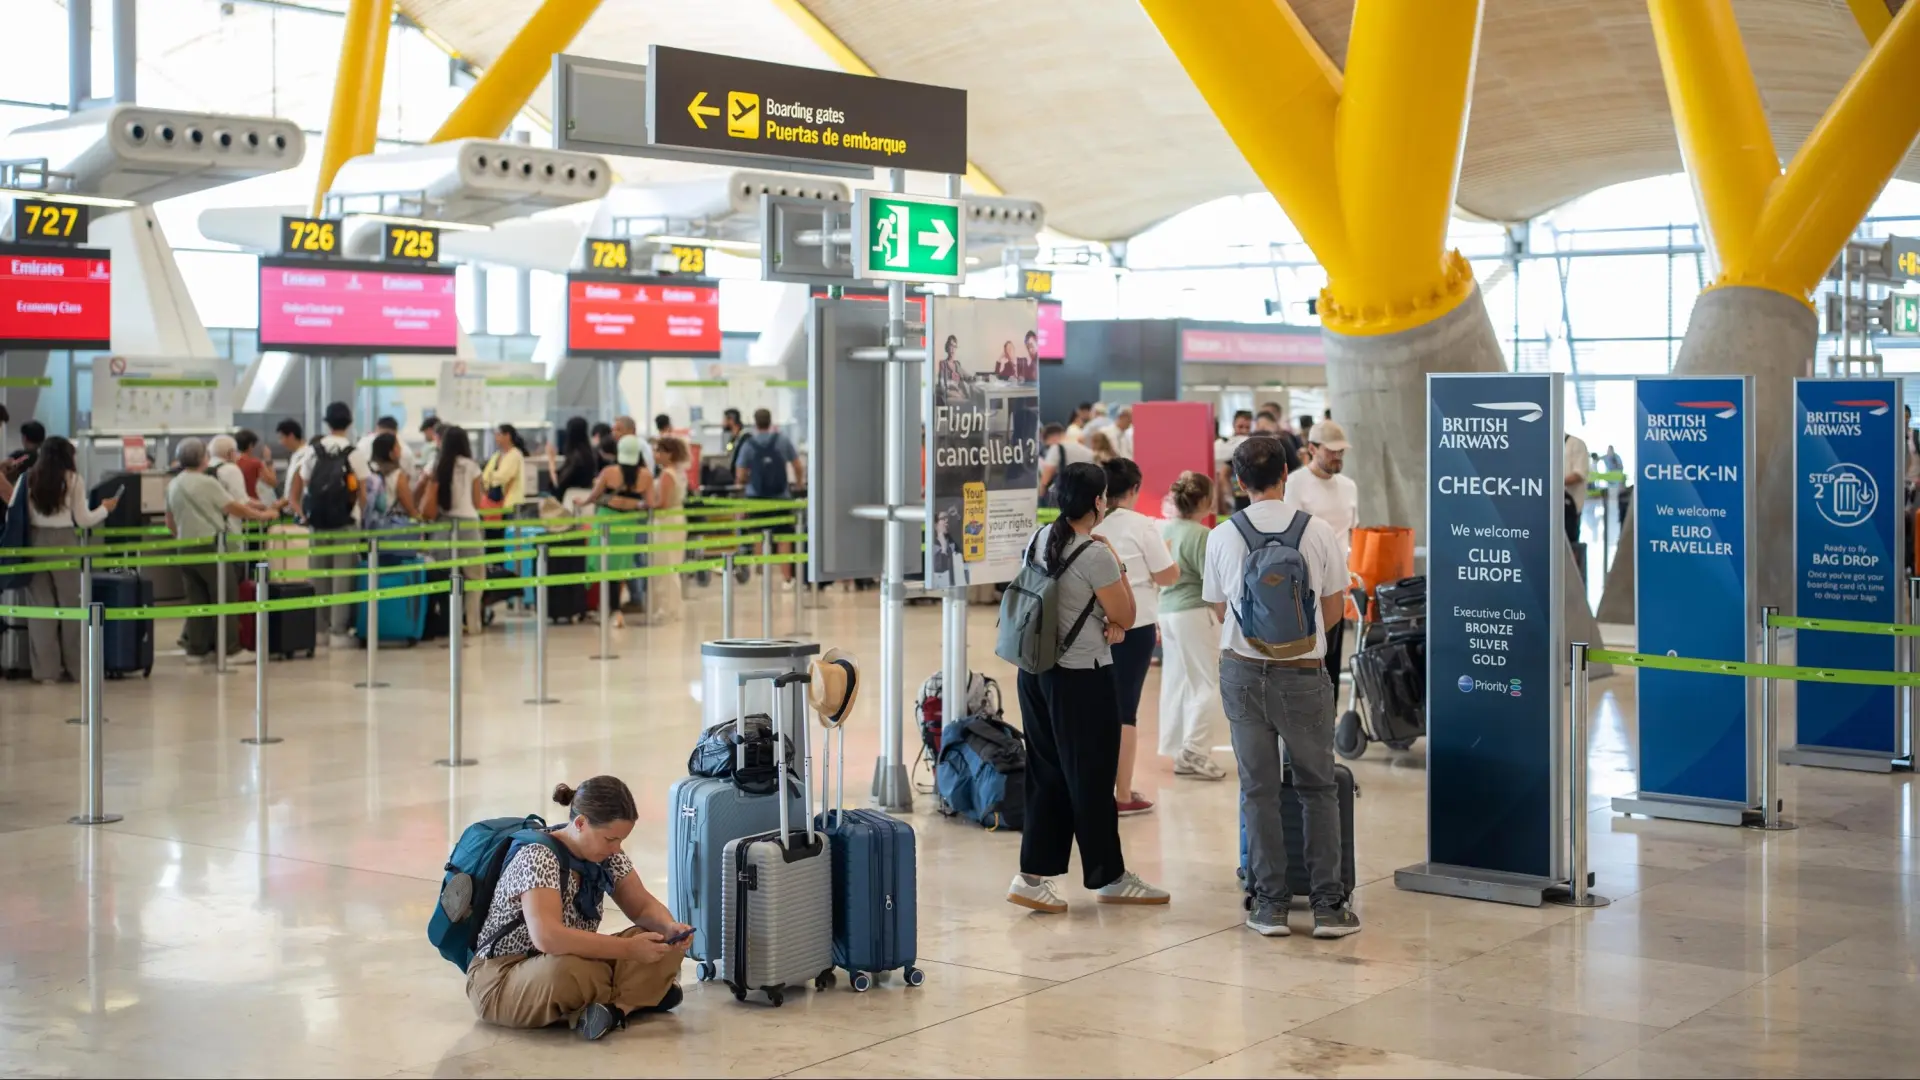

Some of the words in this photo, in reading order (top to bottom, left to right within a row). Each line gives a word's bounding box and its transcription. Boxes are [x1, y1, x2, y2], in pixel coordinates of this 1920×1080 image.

[766, 98, 813, 124] Boarding
[816, 107, 845, 124] gates
[766, 120, 819, 144] Puertas
[822, 127, 839, 146] de
[843, 131, 906, 156] embarque
[24, 205, 79, 236] 727
[290, 221, 335, 251] 726
[391, 229, 435, 259] 725
[592, 242, 627, 268] 724
[11, 259, 64, 276] Emirates
[936, 405, 990, 439] Flight
[1648, 414, 1706, 428] BRITISH
[1806, 411, 1860, 424] BRITISH
[1442, 417, 1507, 433] BRITISH
[1804, 424, 1862, 436] AIRWAYS
[1439, 434, 1509, 449] AIRWAYS
[1644, 428, 1708, 442] AIRWAYS
[936, 438, 1024, 467] cancelled
[1644, 464, 1738, 482] CHECK-IN
[1809, 473, 1836, 484] STEP
[1438, 476, 1543, 496] CHECK-IN
[1814, 484, 1824, 499] 2
[965, 488, 984, 499] Your
[965, 505, 984, 516] rights
[1656, 504, 1674, 516] We
[1677, 505, 1726, 517] welcome
[988, 520, 1007, 533] your
[1009, 517, 1033, 532] rights
[1451, 524, 1470, 537] We
[1474, 525, 1529, 539] welcome
[1671, 525, 1712, 538] EURO
[1649, 540, 1733, 555] TRAVELLER
[1824, 544, 1847, 553] Ready
[1858, 545, 1867, 554] fly
[1468, 548, 1511, 563] CLUB
[1812, 553, 1839, 566] BAG
[1843, 554, 1879, 567] DROP
[1458, 566, 1522, 582] EUROPE
[1807, 570, 1827, 579] Once
[1829, 572, 1852, 580] you've
[1853, 573, 1866, 581] got
[1807, 581, 1838, 590] boarding
[1839, 582, 1855, 590] card
[1824, 592, 1840, 601] drop
[1843, 594, 1859, 602] your
[1860, 594, 1877, 603] bags
[1453, 606, 1500, 619] Executive
[1503, 609, 1526, 620] Club
[1465, 622, 1513, 635] BRONZE
[1469, 638, 1509, 651] SILVER
[1472, 654, 1506, 666] GOLD
[1475, 680, 1508, 693] Priority
